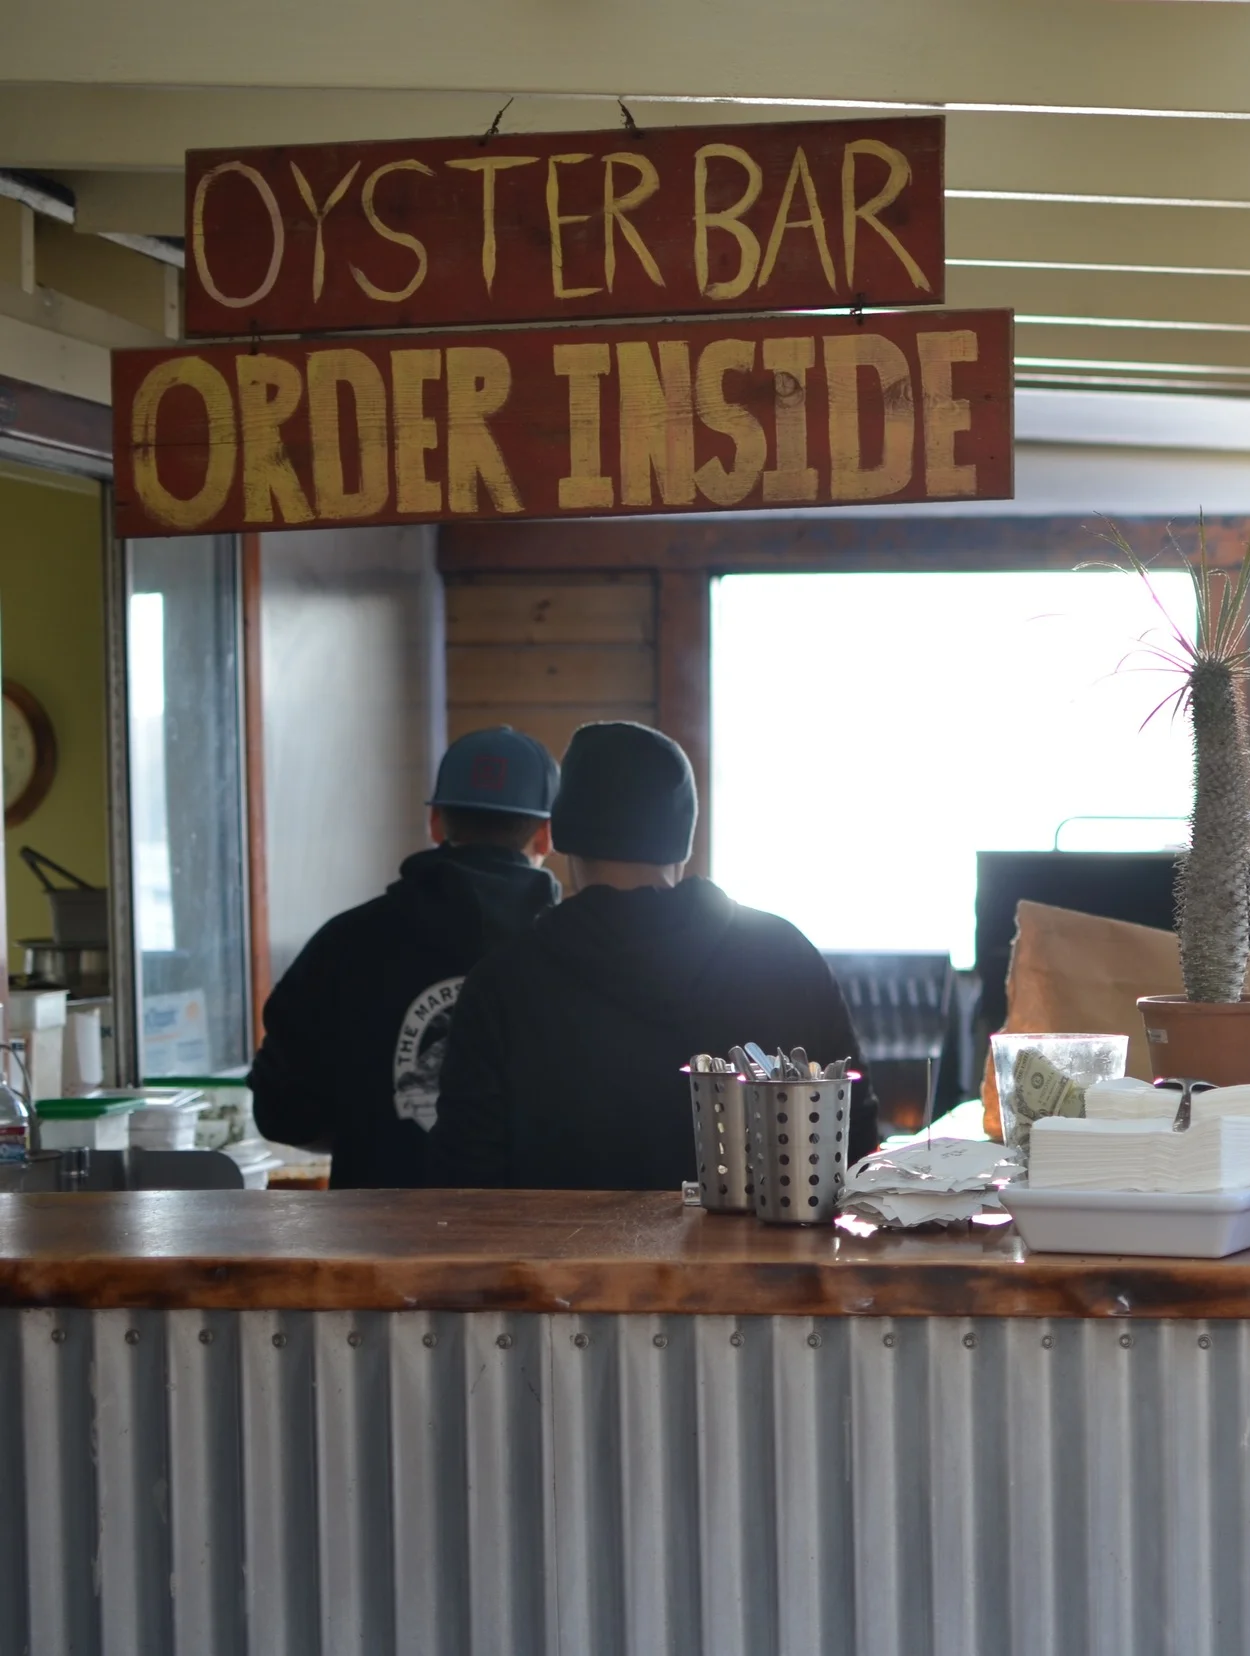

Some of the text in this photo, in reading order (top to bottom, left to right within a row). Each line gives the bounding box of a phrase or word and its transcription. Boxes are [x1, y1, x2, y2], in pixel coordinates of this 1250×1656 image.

[192, 139, 931, 308] OYSTER BAR
[131, 329, 979, 528] ORDER INSIDE
[398, 1024, 418, 1066] THE
